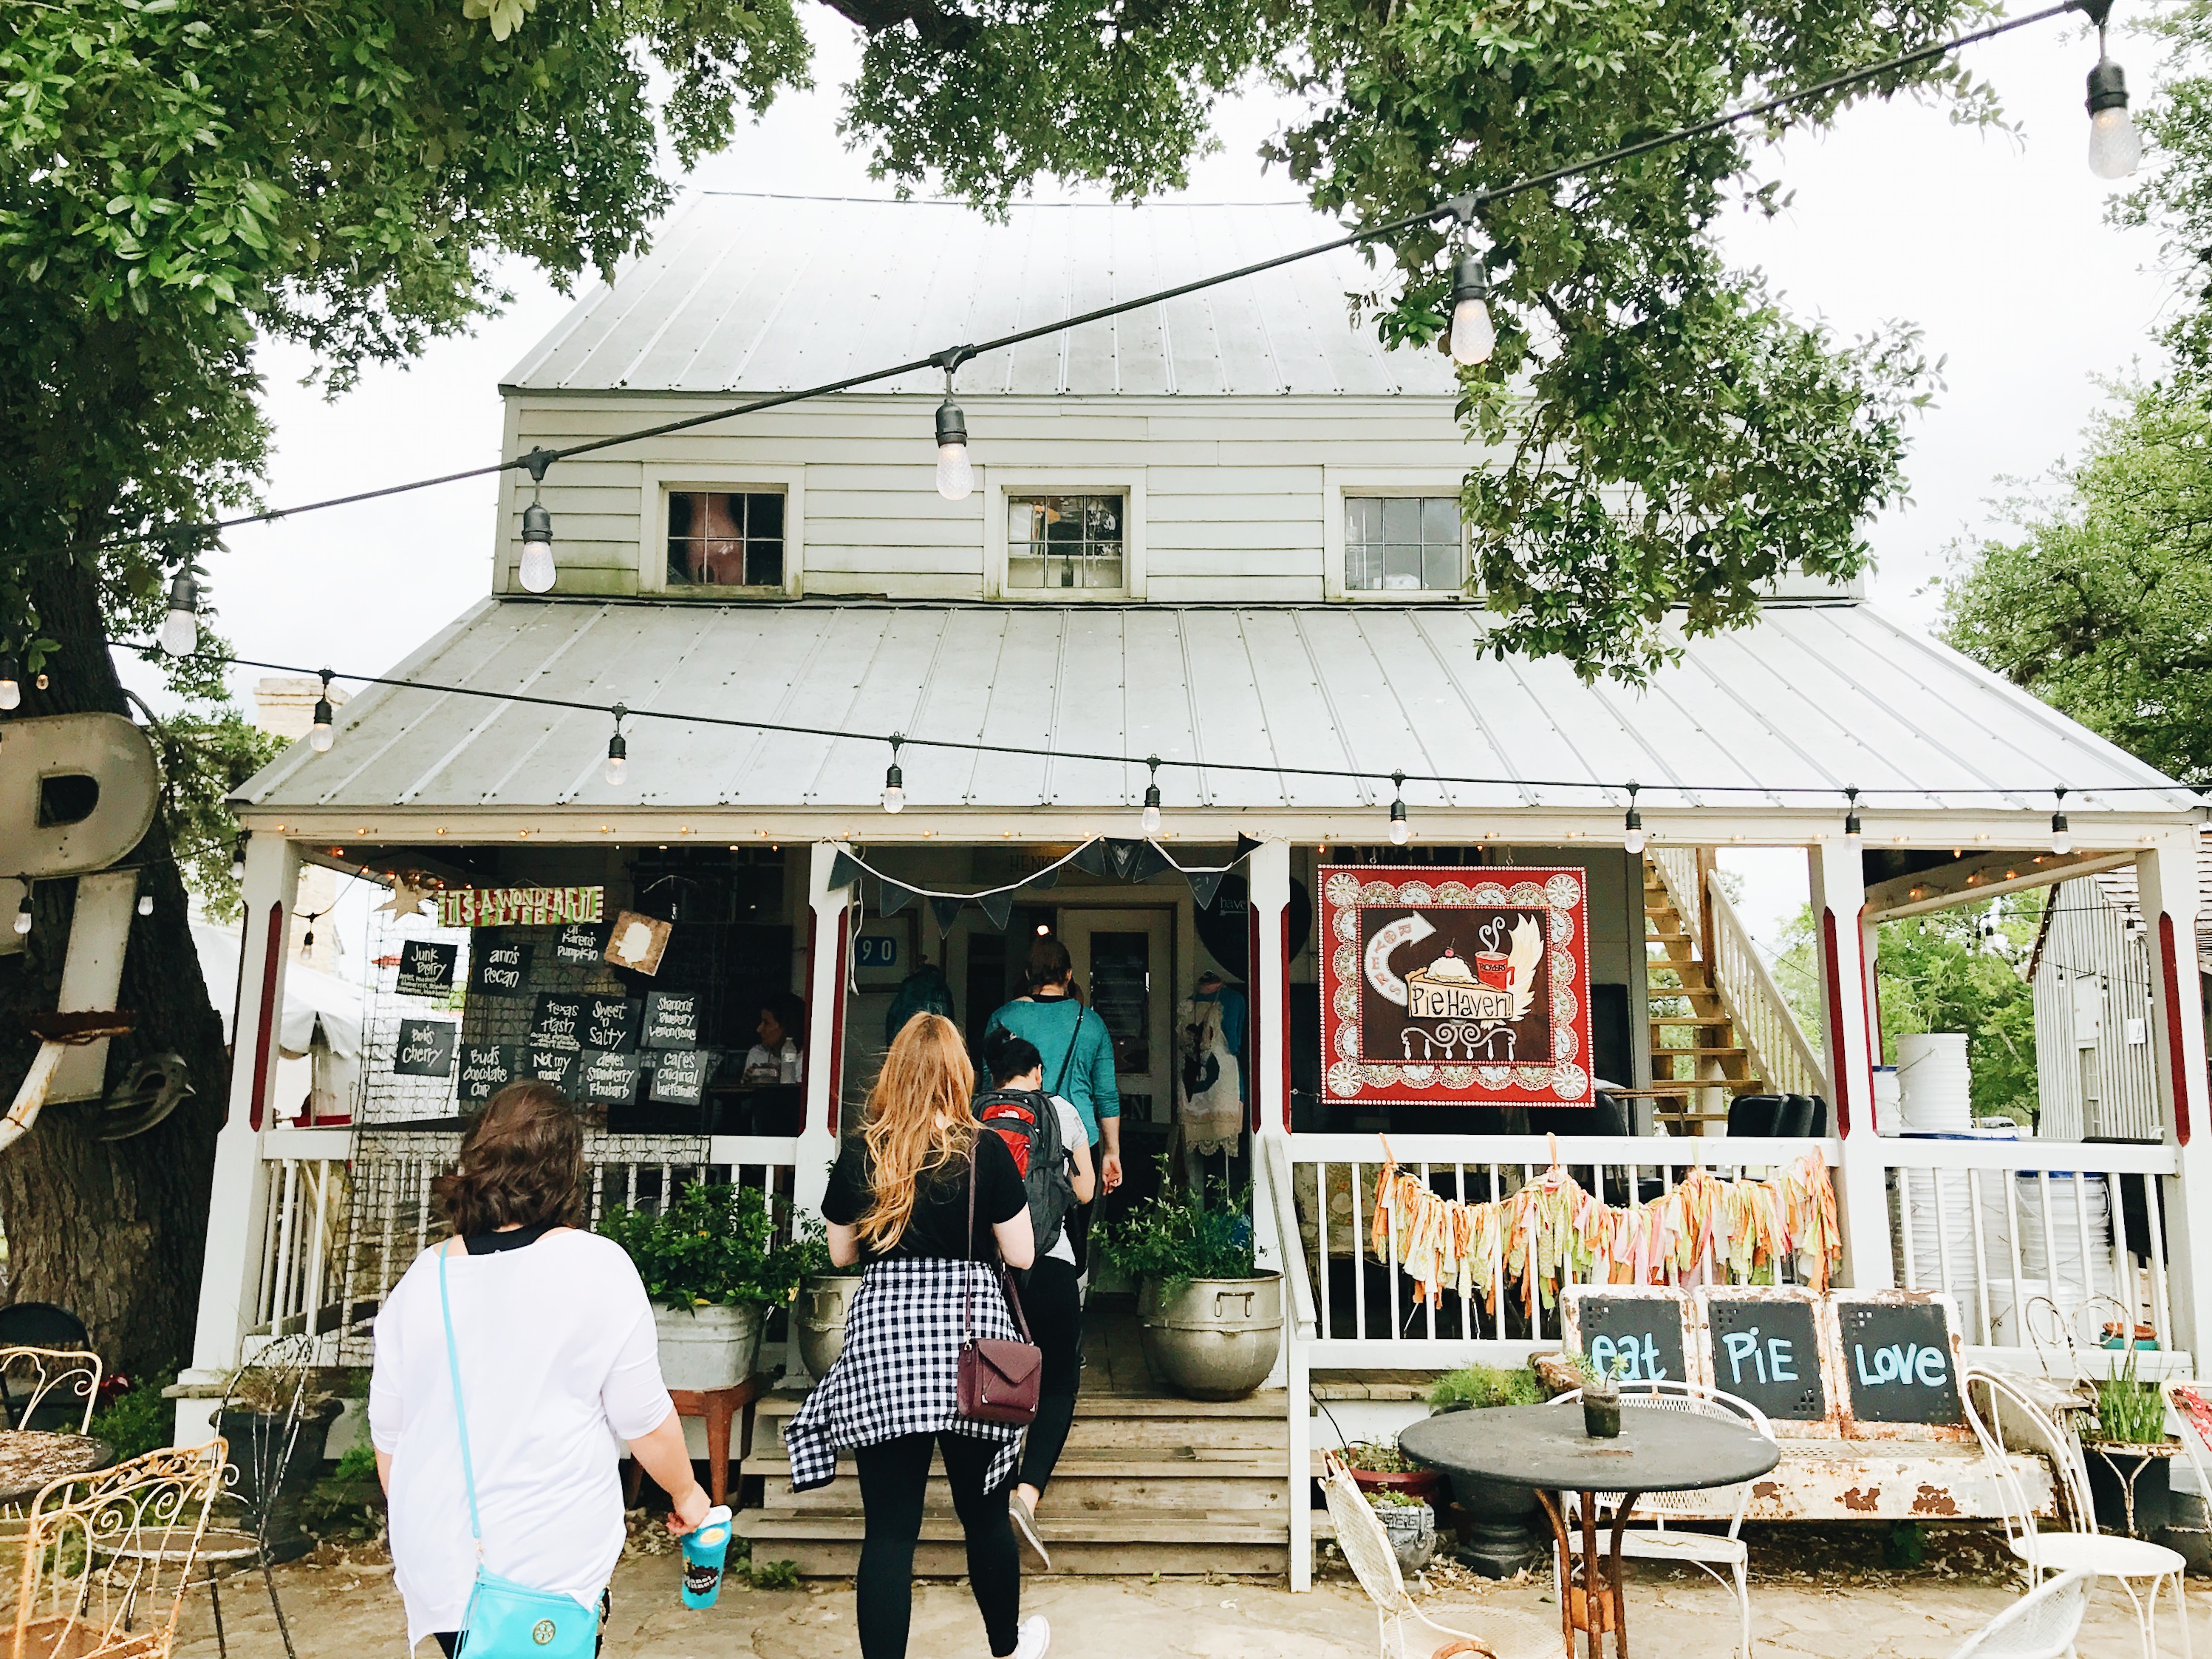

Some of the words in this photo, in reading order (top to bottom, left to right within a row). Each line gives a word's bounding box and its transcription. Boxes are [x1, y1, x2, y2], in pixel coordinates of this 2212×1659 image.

[478, 890, 496, 916] A
[494, 887, 597, 923] WONDERFUL
[497, 906, 545, 925] LIFE
[411, 944, 440, 963] Junk
[417, 961, 447, 981] Berry
[484, 967, 519, 988] Pecan
[593, 1001, 628, 1021] Sweet
[589, 1026, 627, 1051] Salty
[533, 1052, 553, 1069] Not
[554, 1056, 572, 1075] my
[1591, 1332, 1667, 1380] eat
